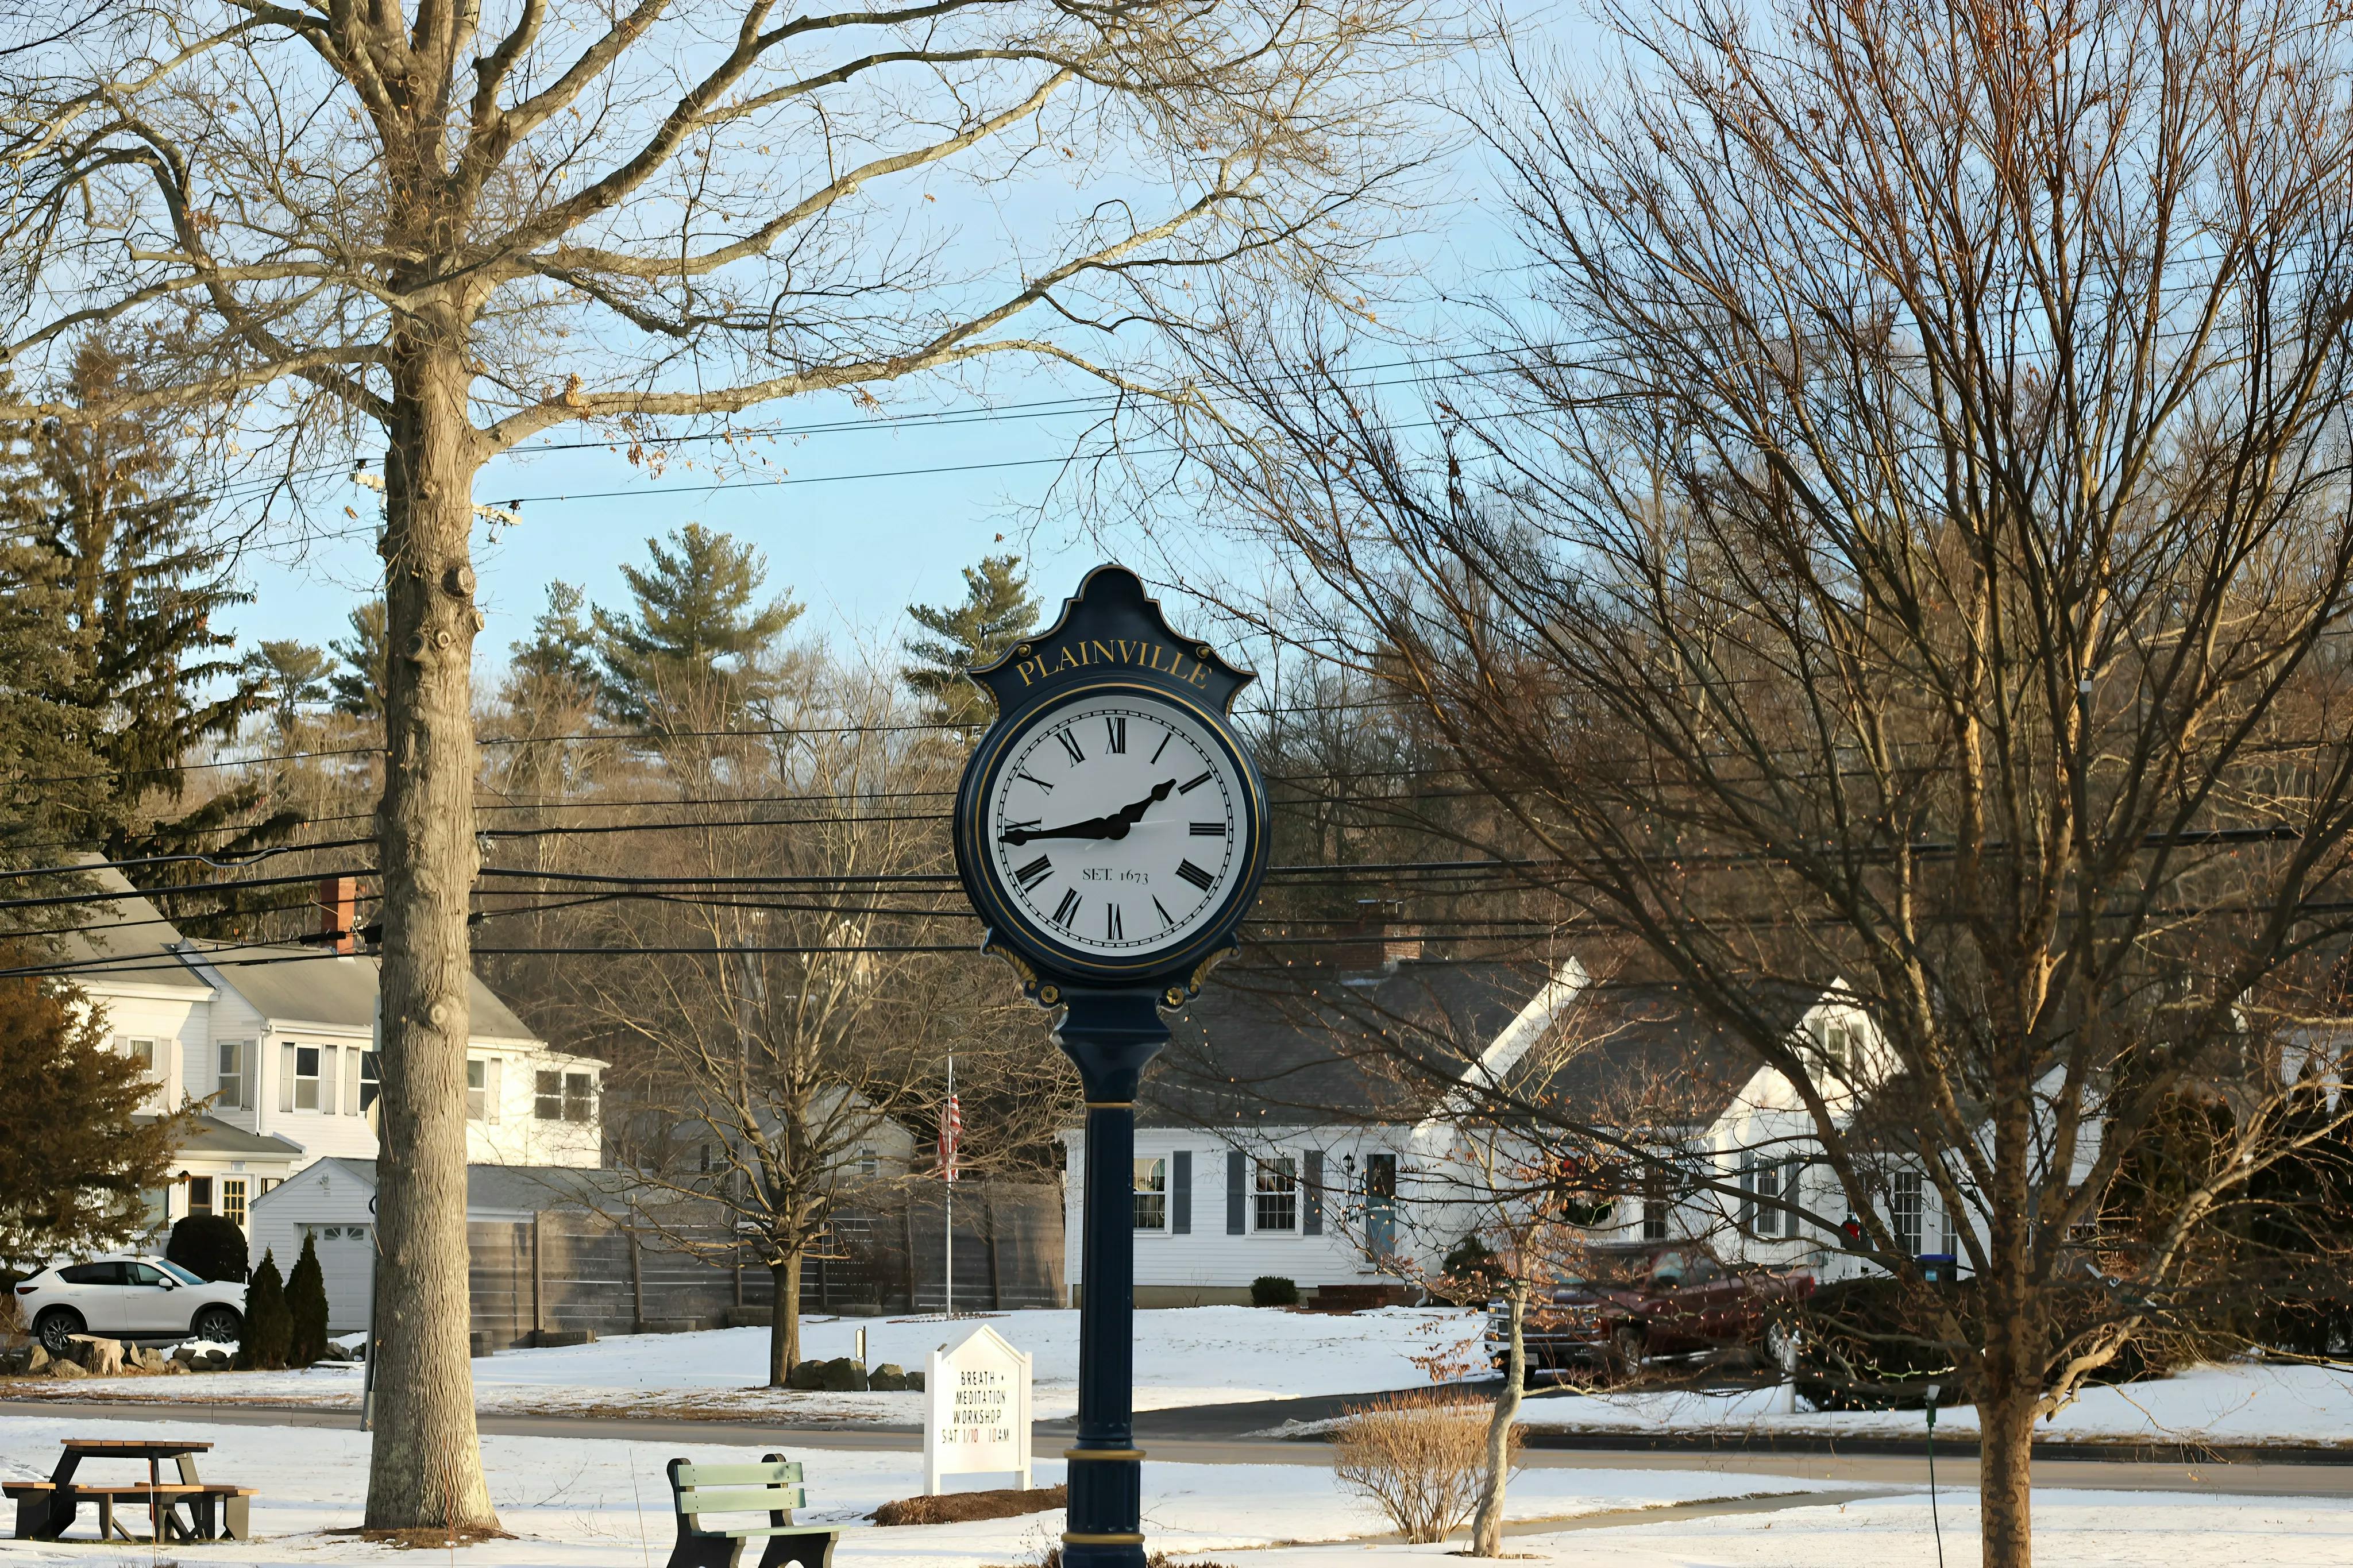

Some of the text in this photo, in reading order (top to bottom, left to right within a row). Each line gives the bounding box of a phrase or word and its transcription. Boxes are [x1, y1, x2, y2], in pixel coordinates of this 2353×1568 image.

[1016, 639, 1212, 689] PLAINVILLE
[1055, 727, 1086, 768] XI
[1106, 717, 1126, 754] XII
[1150, 731, 1174, 764] I
[1017, 766, 1054, 795] X
[1178, 770, 1213, 795] II
[1004, 816, 1042, 834] X
[1189, 821, 1226, 839] III
[1014, 853, 1055, 894] VIII
[1082, 868, 1148, 885] SET. 1673
[1175, 858, 1215, 893] IIII
[1052, 886, 1082, 929] VII
[1107, 903, 1125, 940] VI
[1152, 894, 1174, 929] V
[961, 1371, 994, 1385] BREATH
[956, 1390, 1005, 1404] MEDITATION
[954, 1409, 1001, 1424] WORKSHOP
[942, 1429, 958, 1443] SAT
[963, 1428, 978, 1443] 1/10
